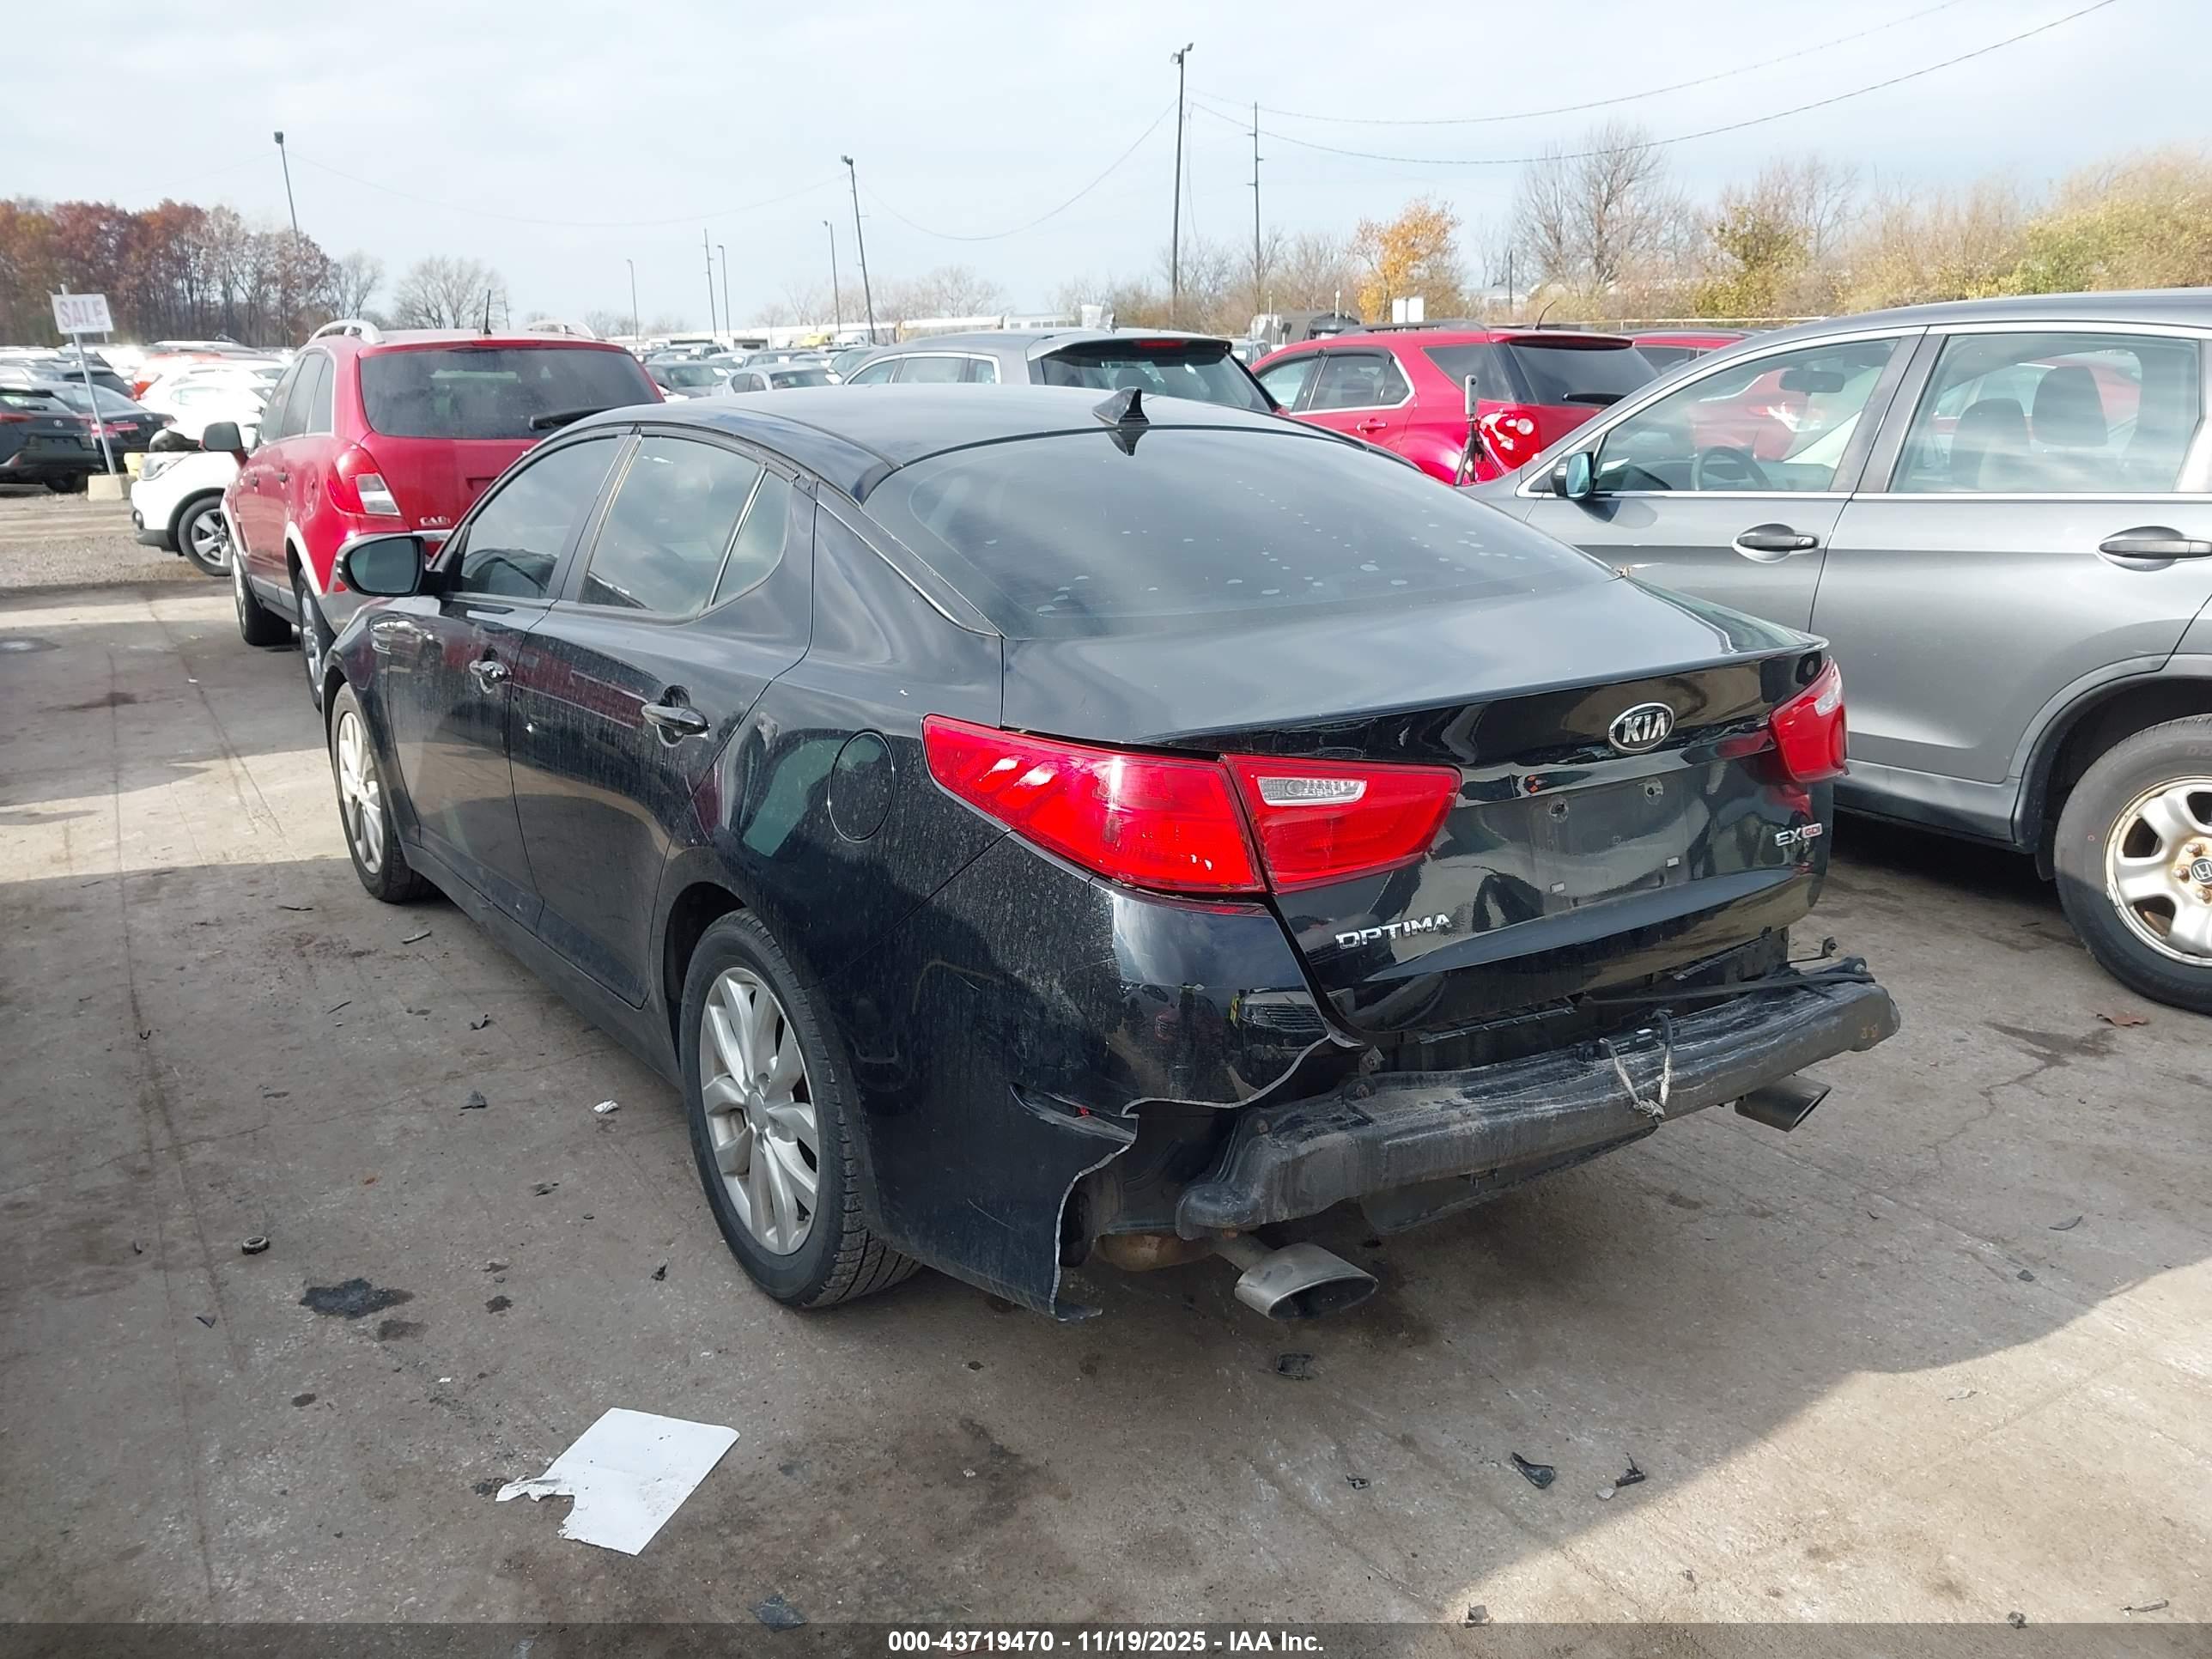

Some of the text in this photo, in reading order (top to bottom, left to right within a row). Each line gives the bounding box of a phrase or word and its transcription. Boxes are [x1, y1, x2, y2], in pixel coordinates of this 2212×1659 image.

[58, 299, 105, 328] SALE
[1622, 712, 1665, 744] KIA
[1335, 913, 1452, 950] OPTIMA
